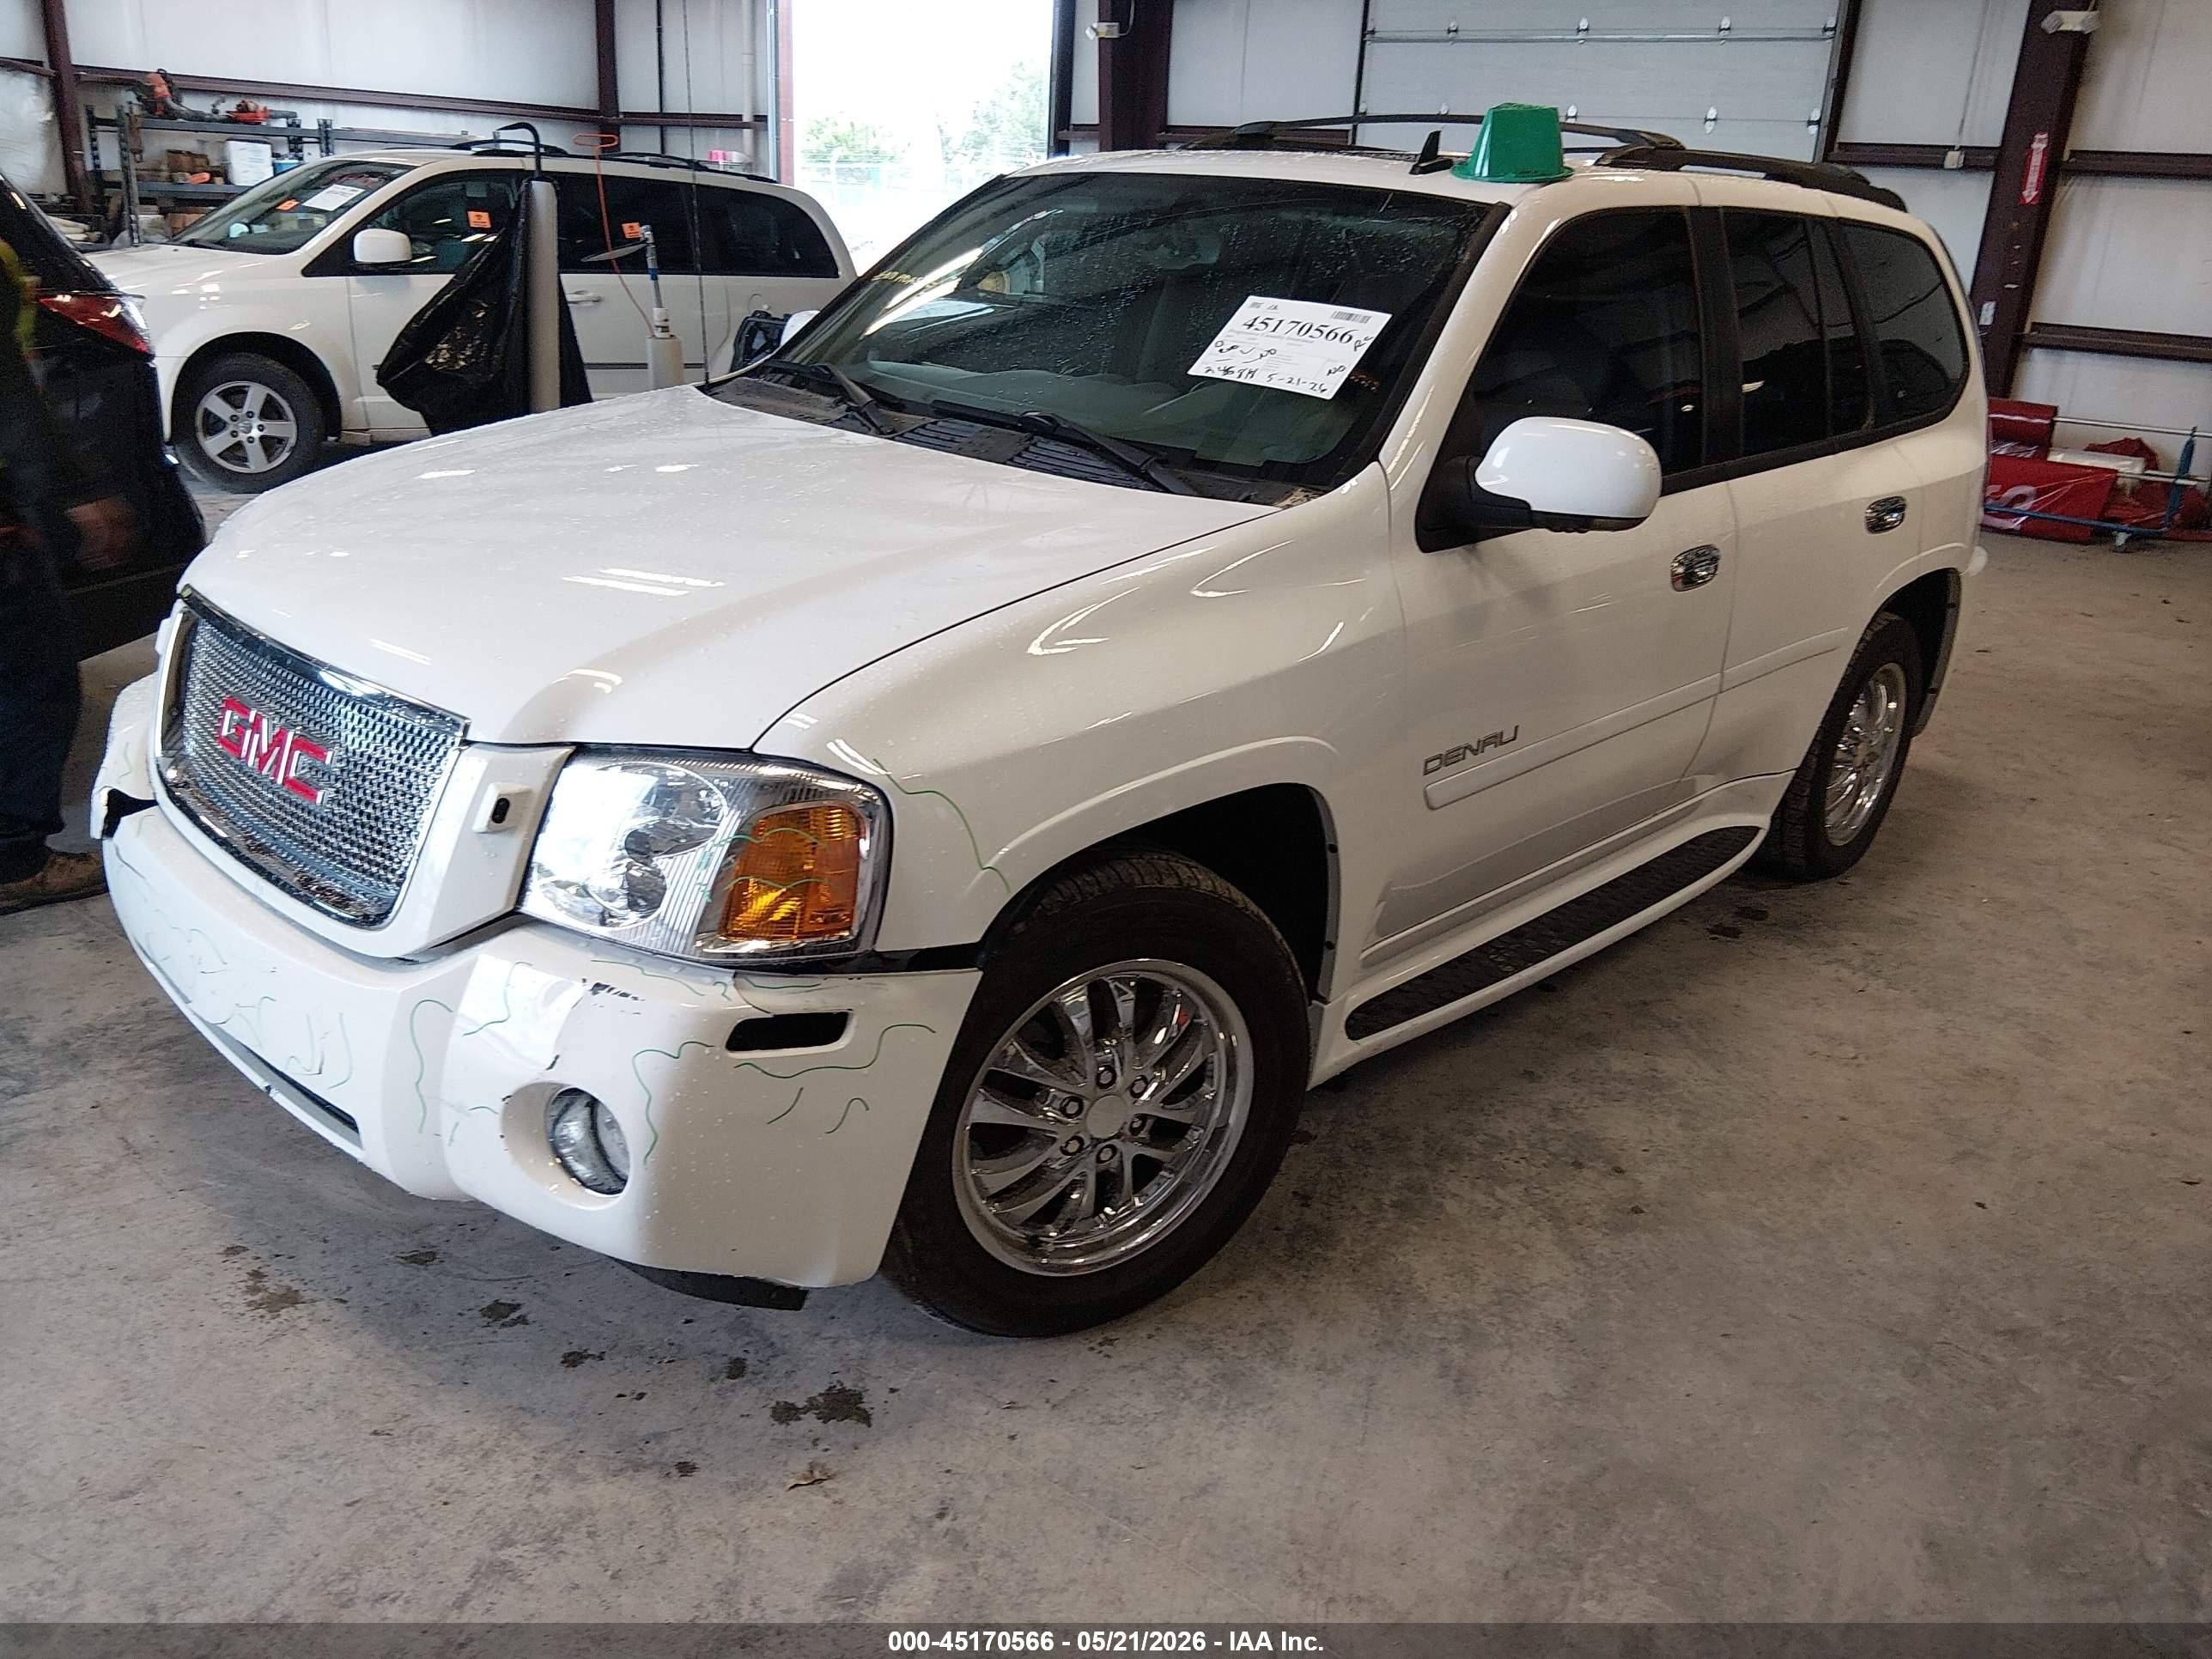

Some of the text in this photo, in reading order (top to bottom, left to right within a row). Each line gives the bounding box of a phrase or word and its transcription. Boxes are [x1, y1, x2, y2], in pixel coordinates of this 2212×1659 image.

[1243, 315, 1360, 344] 45170566
[218, 696, 335, 805] GMC
[1423, 724, 1520, 776] DENALI
